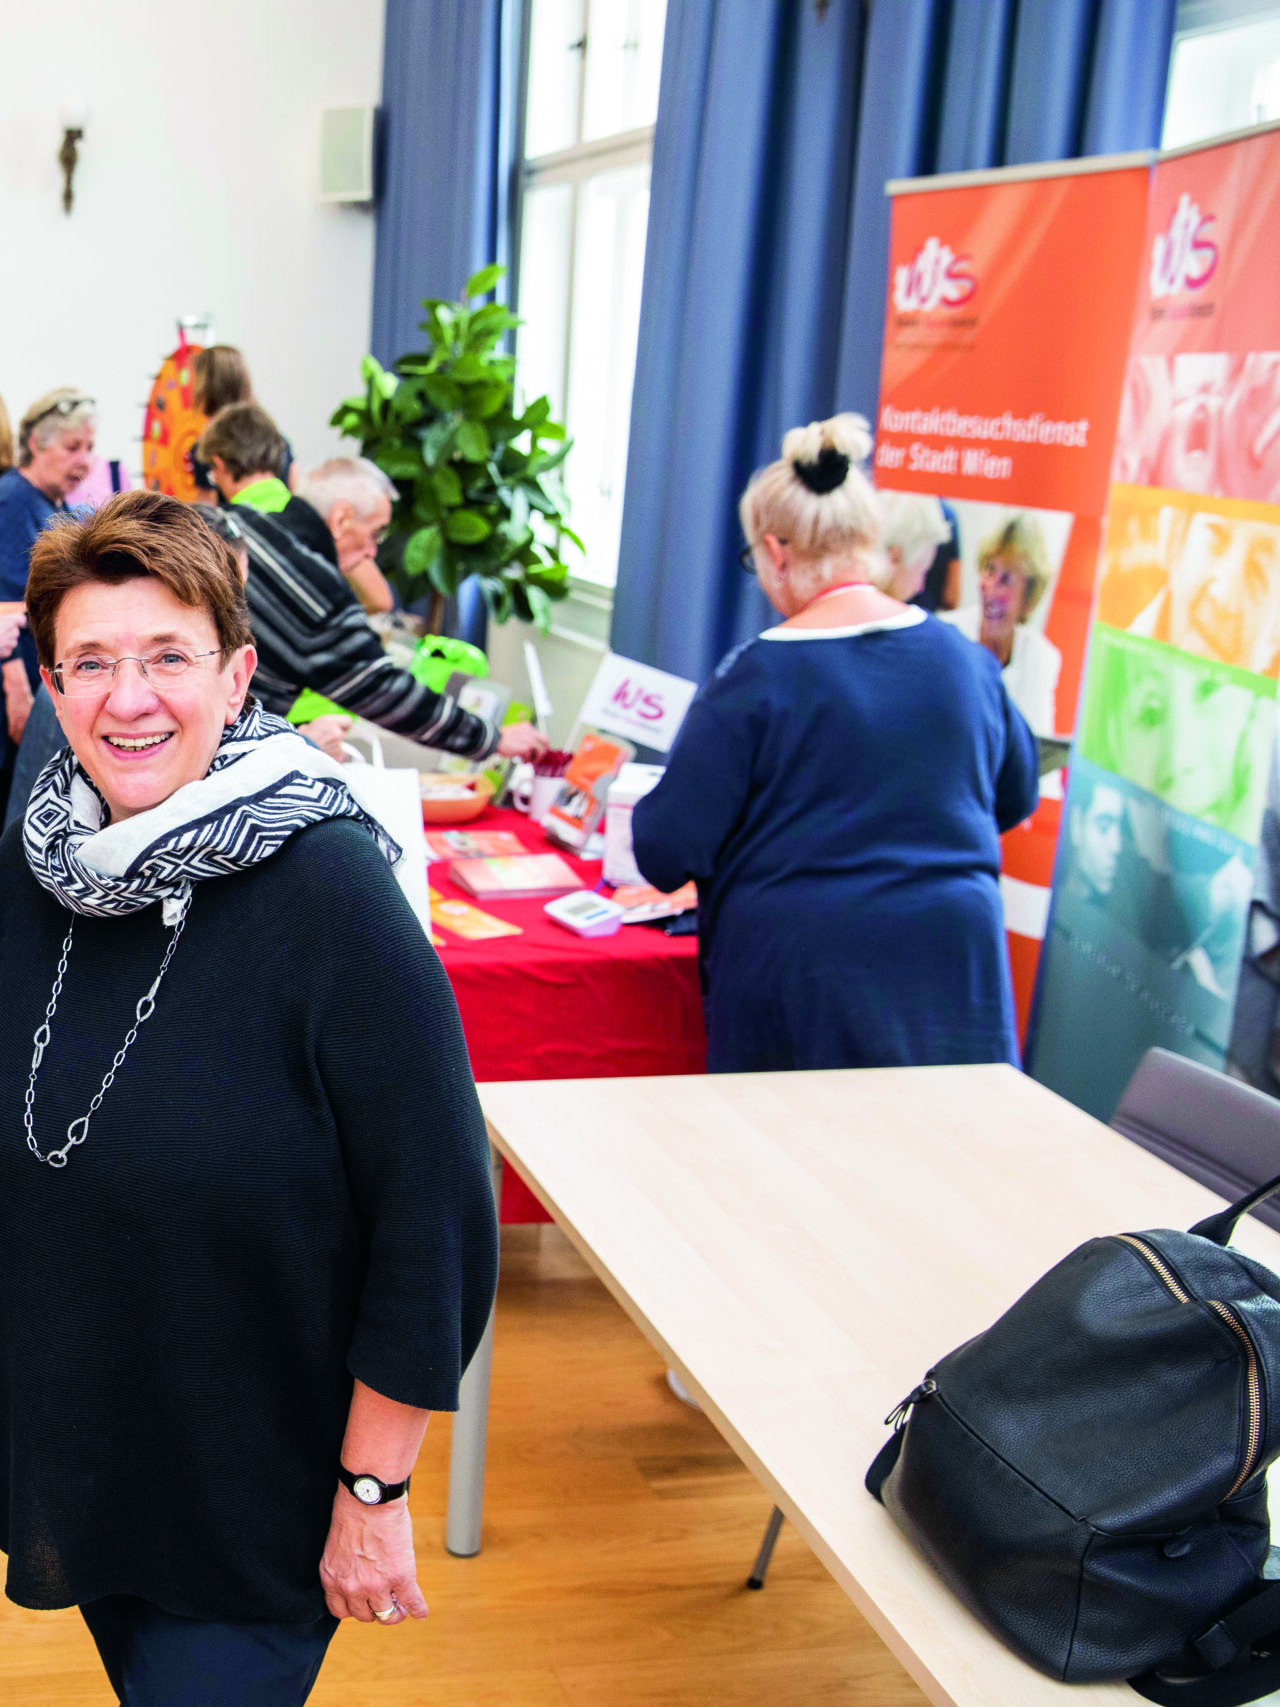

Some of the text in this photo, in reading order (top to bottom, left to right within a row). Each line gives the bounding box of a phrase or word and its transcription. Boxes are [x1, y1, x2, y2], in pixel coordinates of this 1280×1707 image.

[875, 439, 1013, 479] der Stadt Wien
